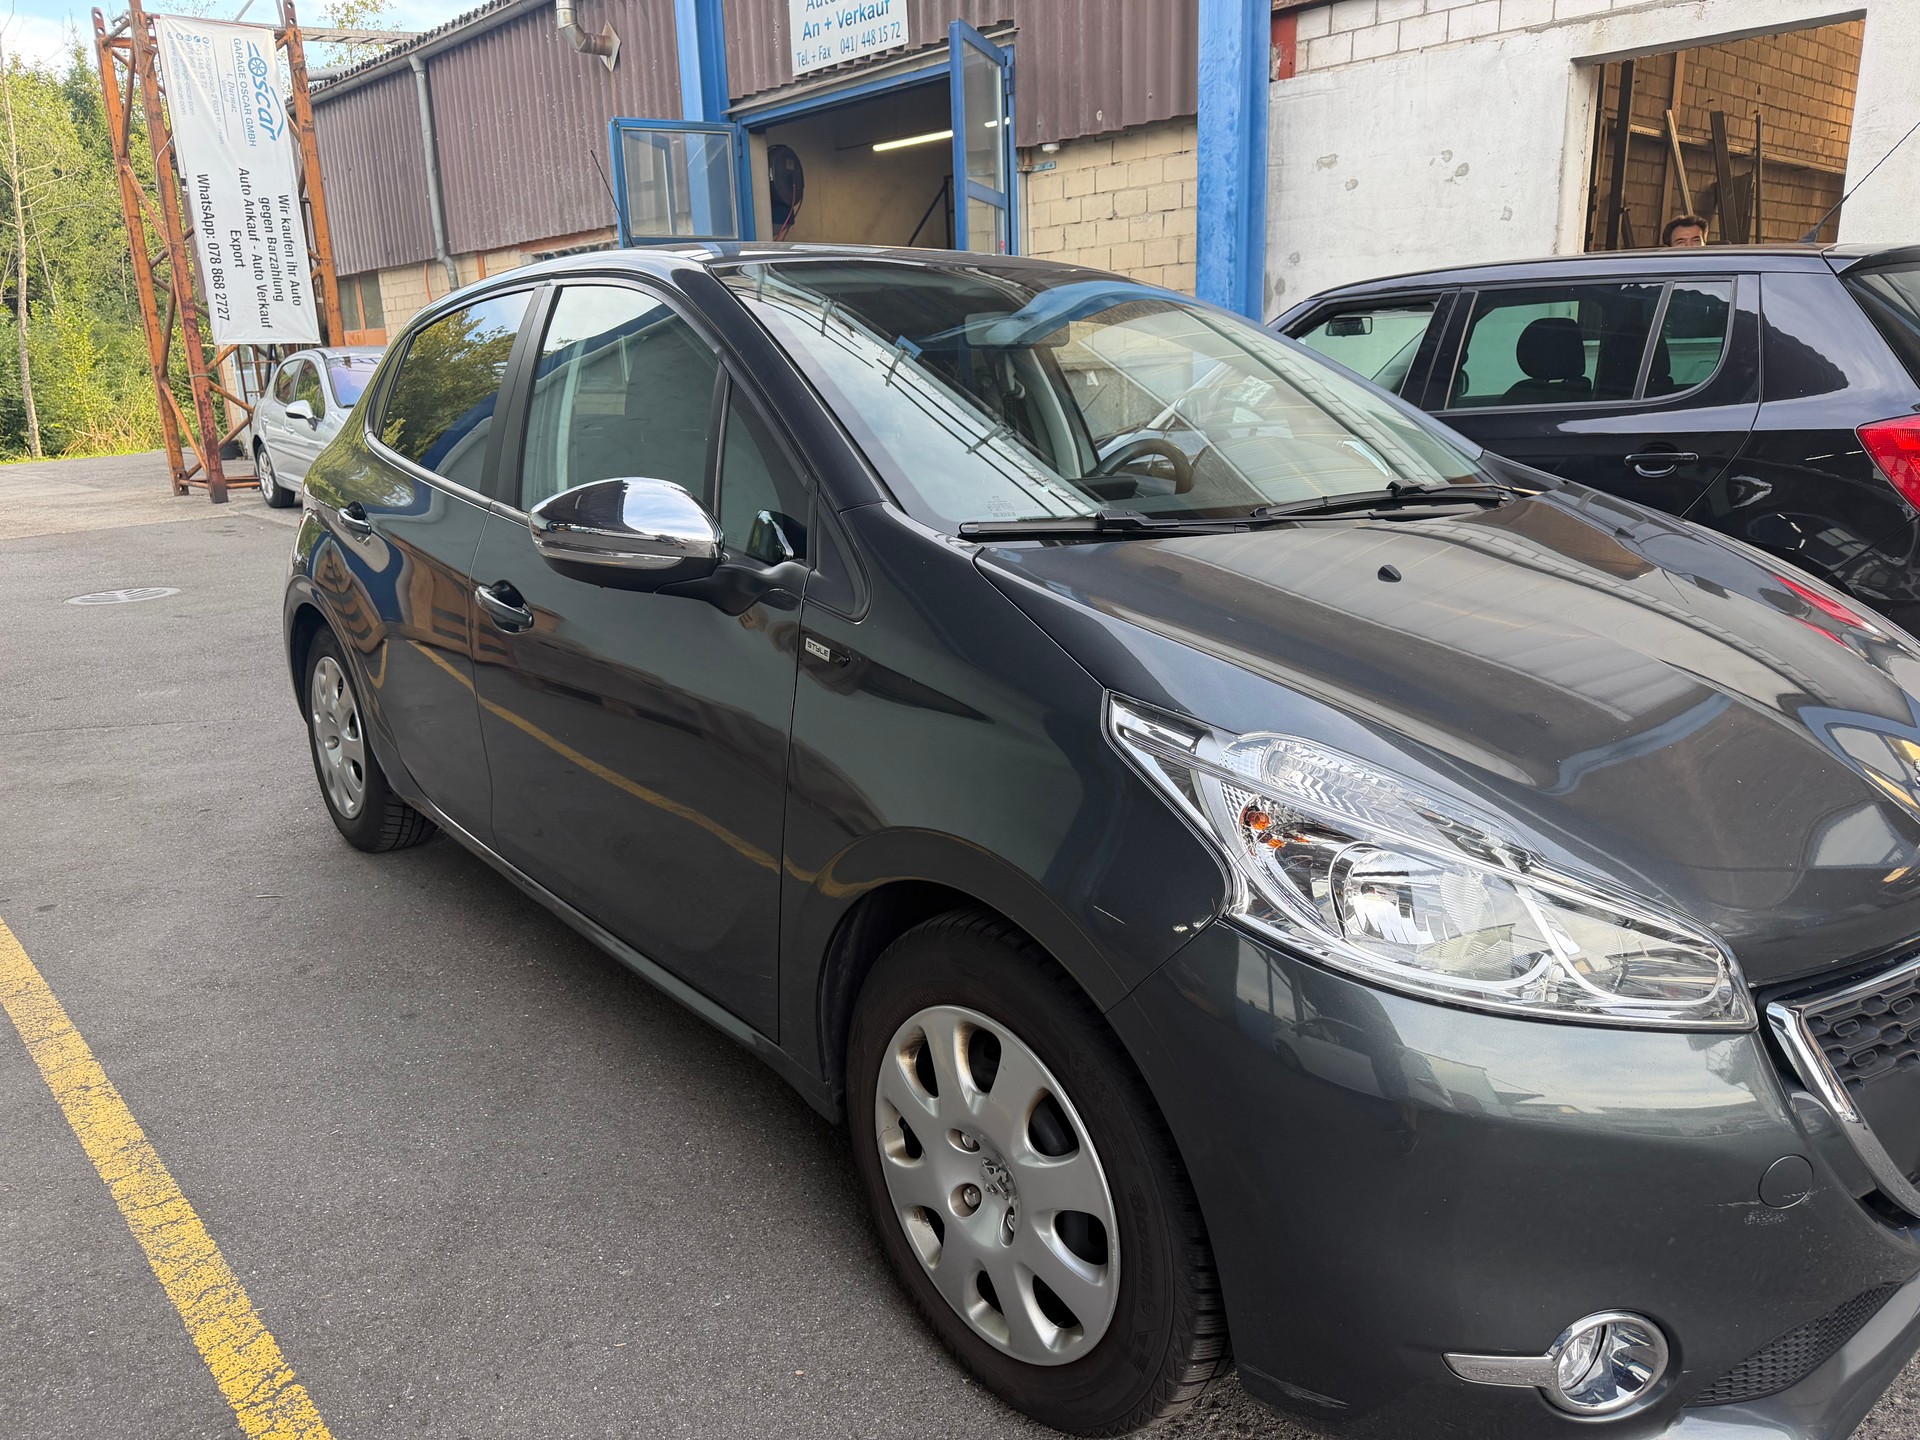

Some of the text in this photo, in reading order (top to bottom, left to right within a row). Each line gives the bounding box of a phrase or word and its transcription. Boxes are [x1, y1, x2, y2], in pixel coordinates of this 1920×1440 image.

[802, 0, 890, 41] An + Verkauf
[796, 49, 810, 67] Tel.
[818, 45, 831, 61] Fax
[861, 29, 876, 48] 448
[878, 25, 888, 43] 15
[891, 21, 901, 40] 72
[233, 38, 257, 147] GARAGE OSCAR GMBH
[238, 167, 251, 196] Auto
[243, 199, 260, 242] Ankauf
[196, 173, 230, 321] WhatsApp: 078 868 2727
[229, 229, 246, 268] Export
[251, 253, 264, 281] Auto
[258, 197, 285, 302] gegen Barzahlung
[277, 194, 301, 306] Wir kaufen ihr Auto
[256, 284, 273, 329] Verkauf
[807, 640, 829, 658] STYLE
